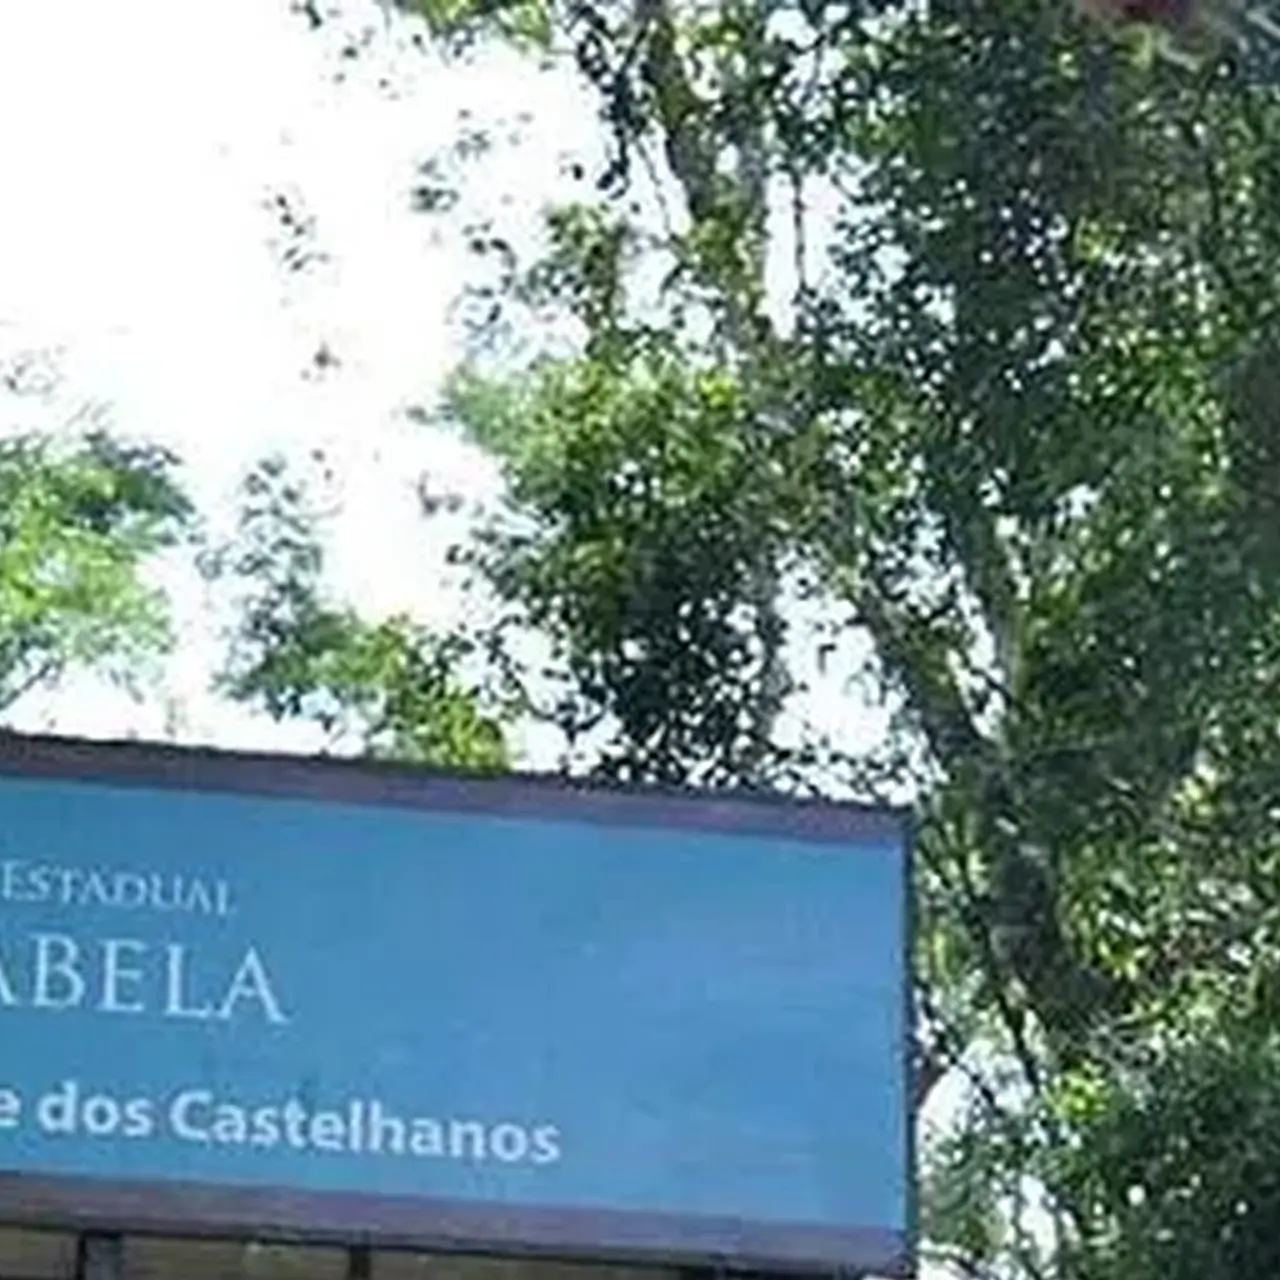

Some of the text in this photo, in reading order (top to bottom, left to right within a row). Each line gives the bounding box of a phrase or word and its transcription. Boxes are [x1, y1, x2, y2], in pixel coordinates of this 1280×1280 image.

[1, 860, 239, 916] ESTADUAL
[39, 1082, 155, 1138] dos
[171, 1090, 561, 1166] Castelhanos
